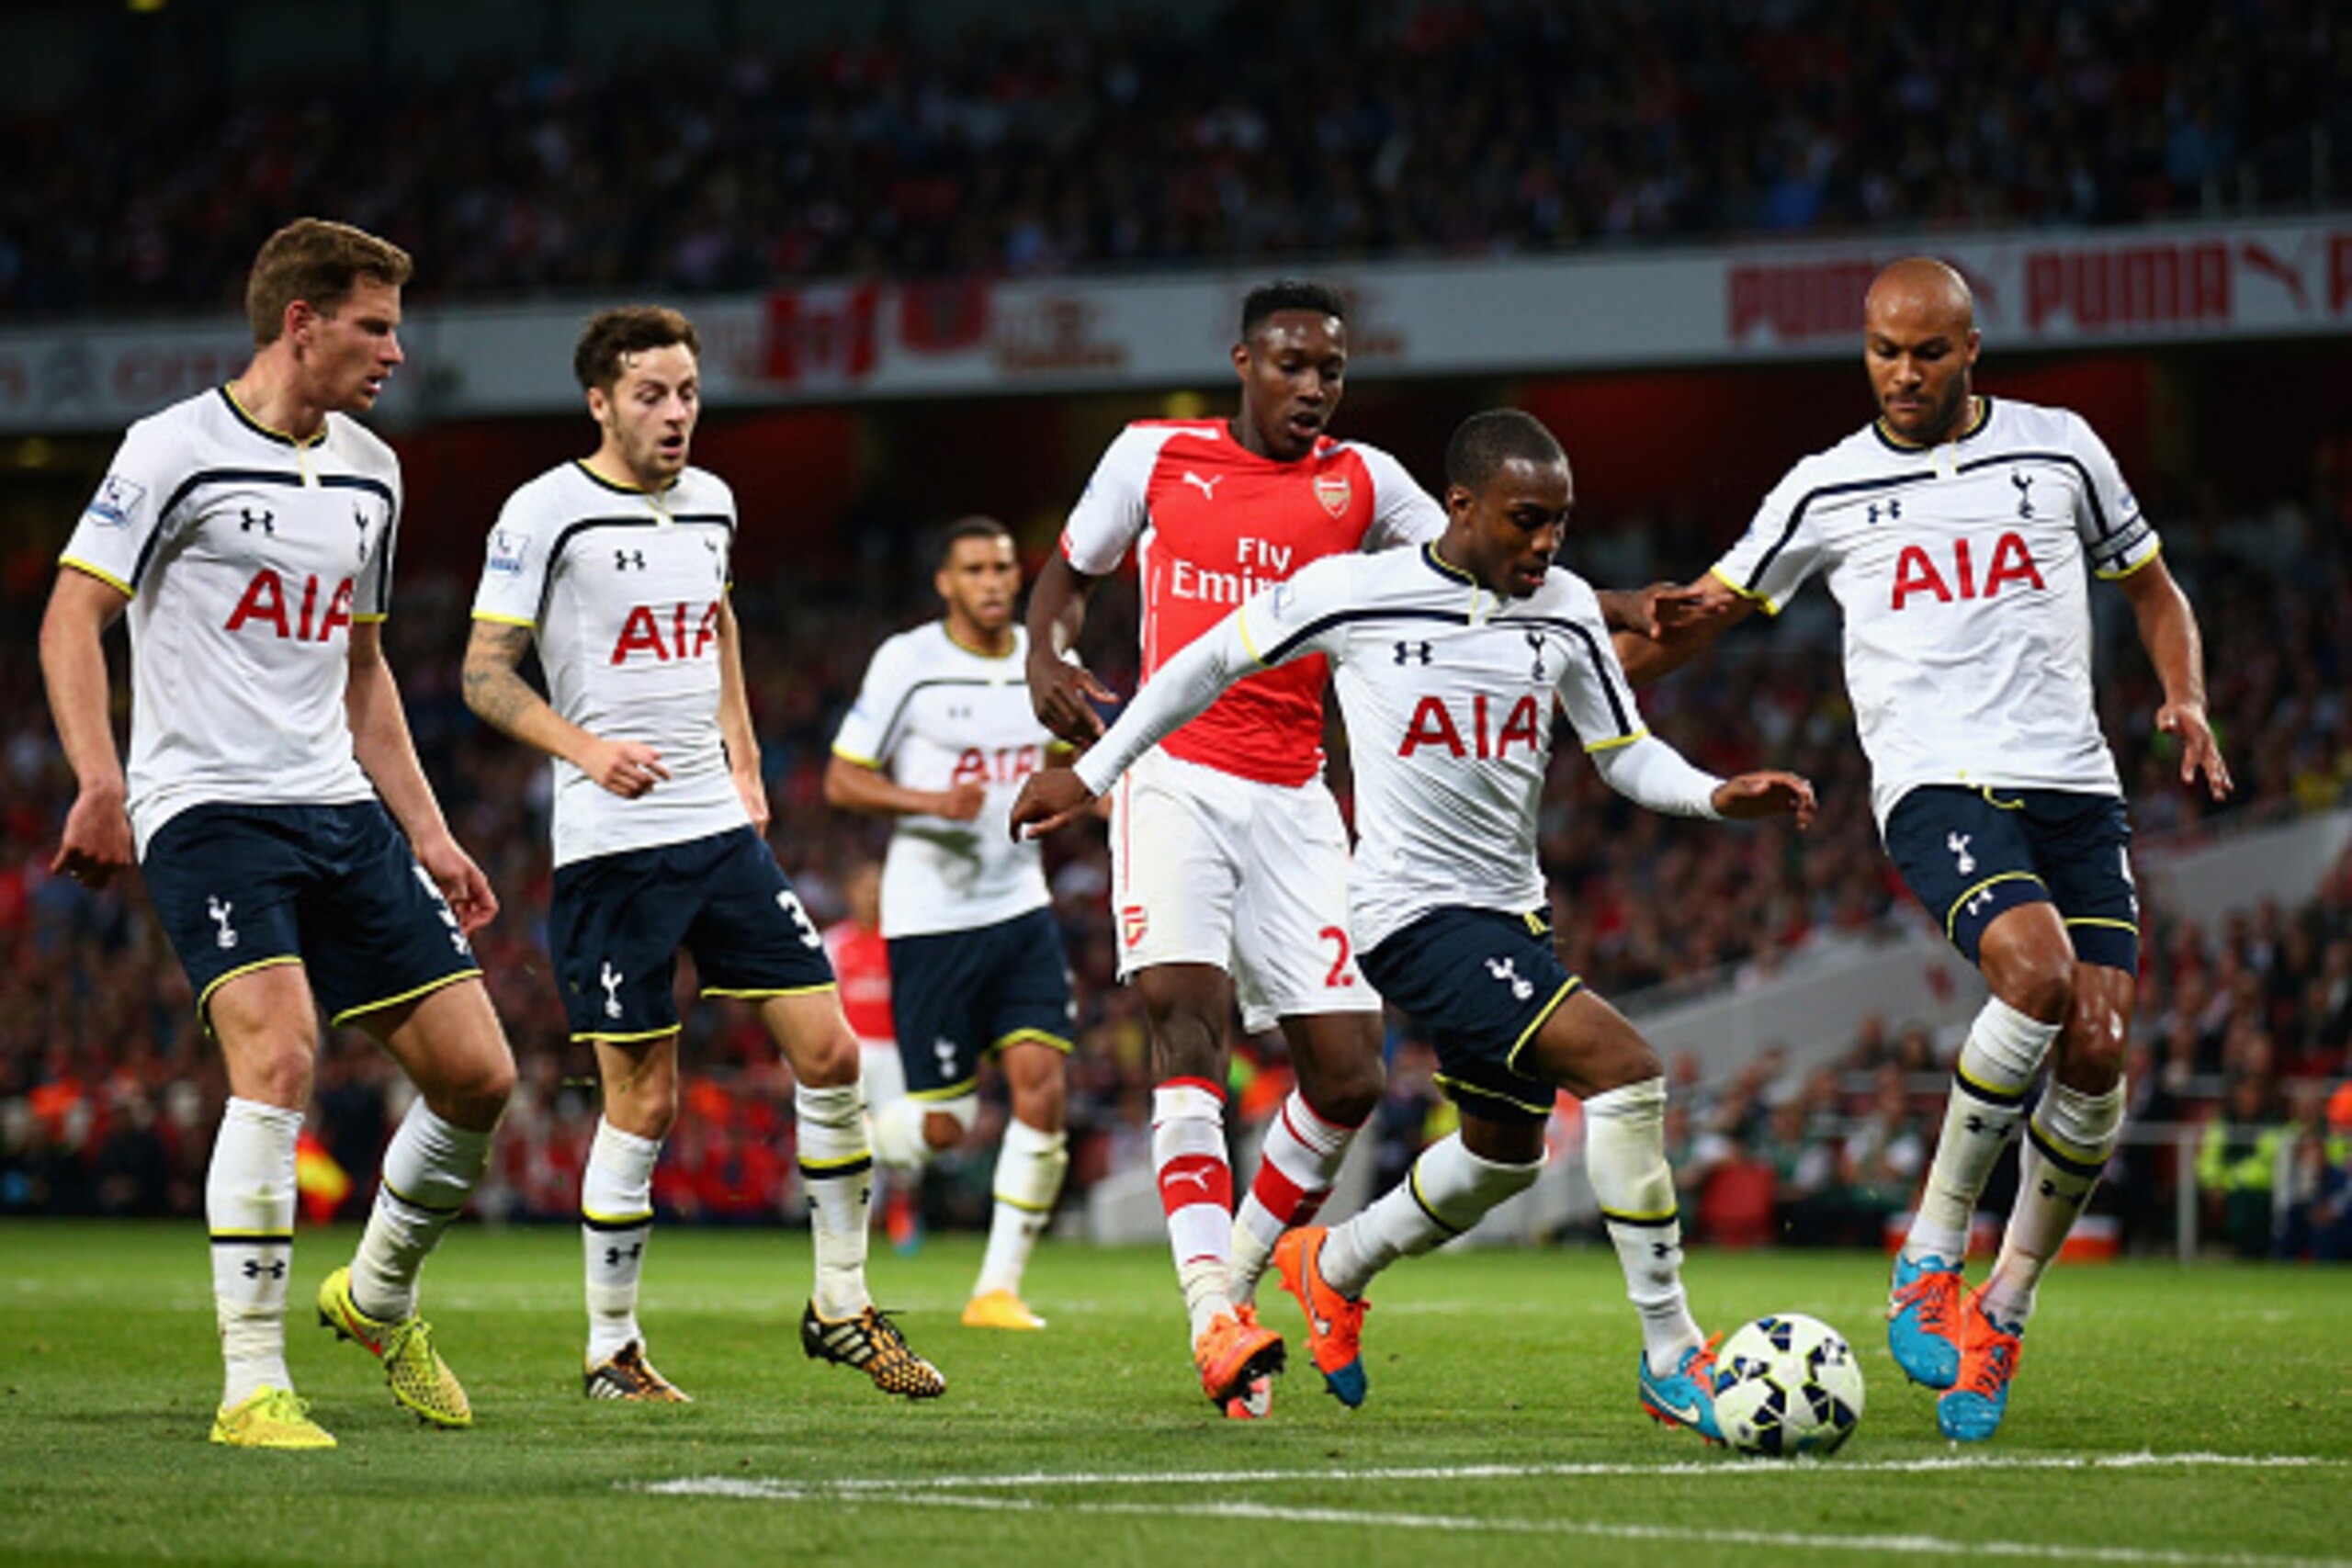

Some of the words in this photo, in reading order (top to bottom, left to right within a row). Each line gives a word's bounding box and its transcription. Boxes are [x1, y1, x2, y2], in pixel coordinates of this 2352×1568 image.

[1729, 259, 1880, 341] PUM
[2027, 241, 2231, 331] PUMA
[1171, 558, 1277, 605] Emir
[1238, 537, 1292, 573] Fly
[1891, 531, 2047, 611] AIA
[224, 570, 356, 642] AIA
[1397, 695, 1539, 760] AIA
[951, 745, 1037, 785] AIA
[1318, 925, 1354, 987] 2
